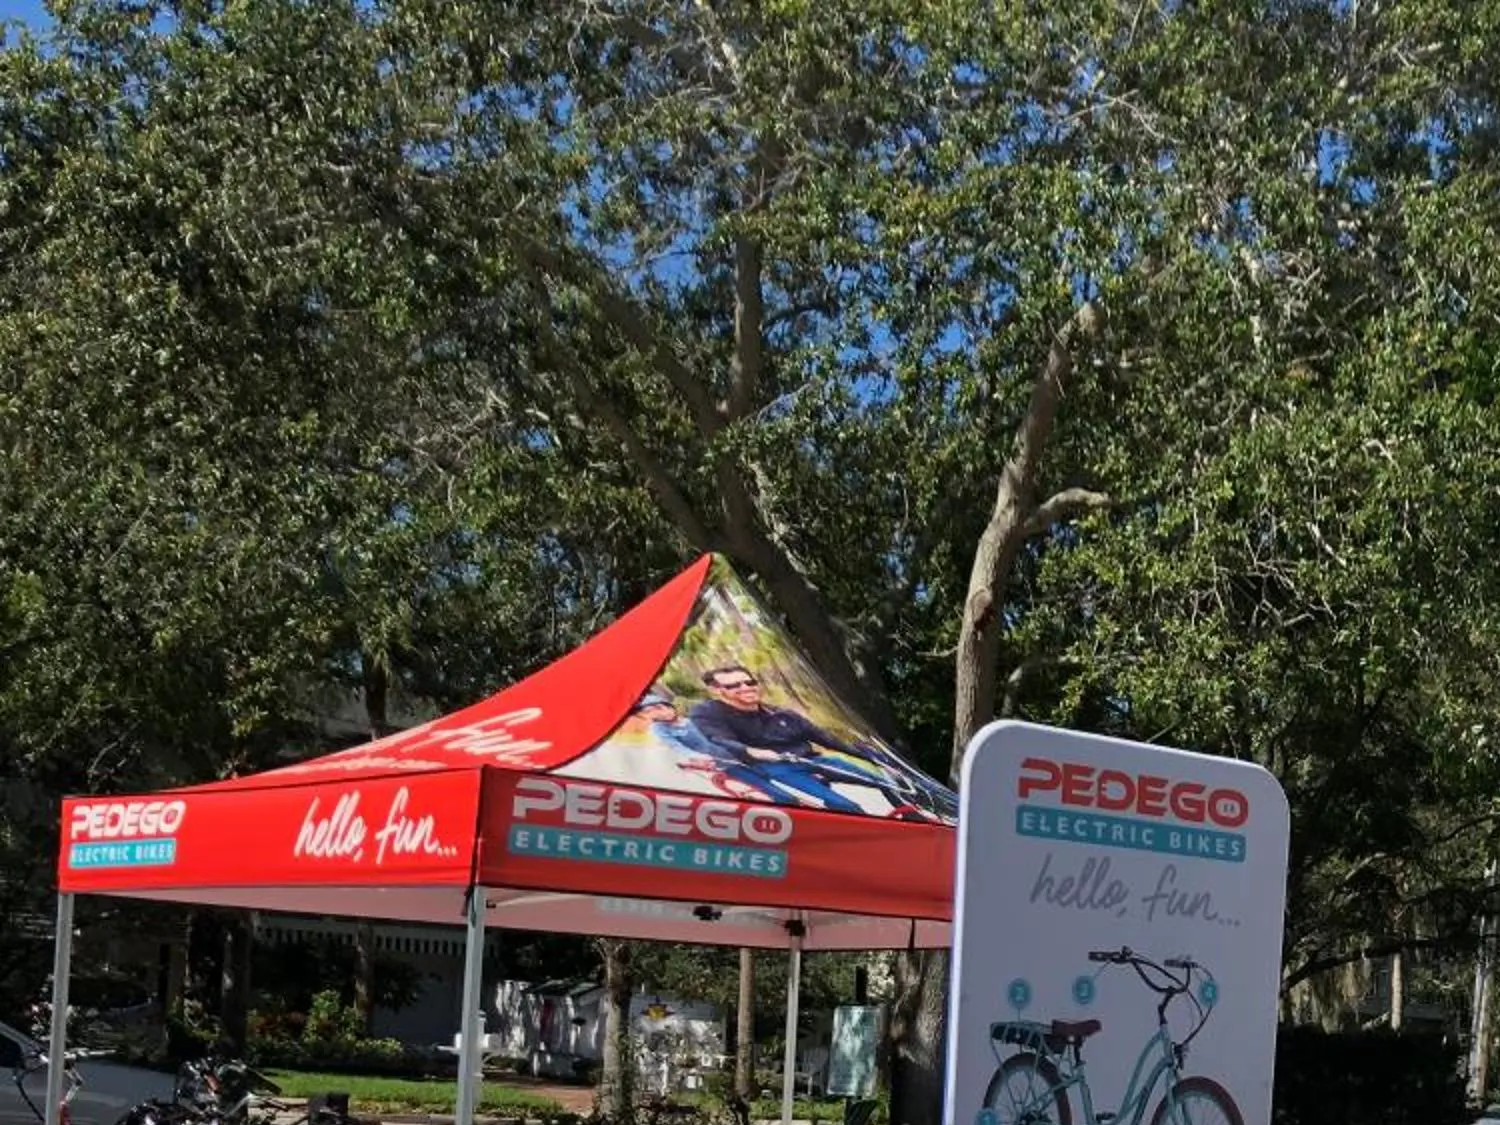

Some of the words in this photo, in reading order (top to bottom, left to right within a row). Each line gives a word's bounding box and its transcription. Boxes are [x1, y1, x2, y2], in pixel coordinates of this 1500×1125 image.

[71, 800, 187, 840] PEDEGO
[293, 788, 368, 863] hello,
[375, 786, 458, 866] fun...
[512, 777, 793, 844] PEDEGO
[1017, 757, 1249, 828] PEDEGO
[515, 829, 676, 862] ELECTRIC
[693, 848, 781, 873] BIKES
[1021, 811, 1154, 846] ELECTRIC
[1169, 832, 1242, 858] BIKES
[1029, 852, 1130, 918] hello,
[1142, 863, 1242, 929] fun...
